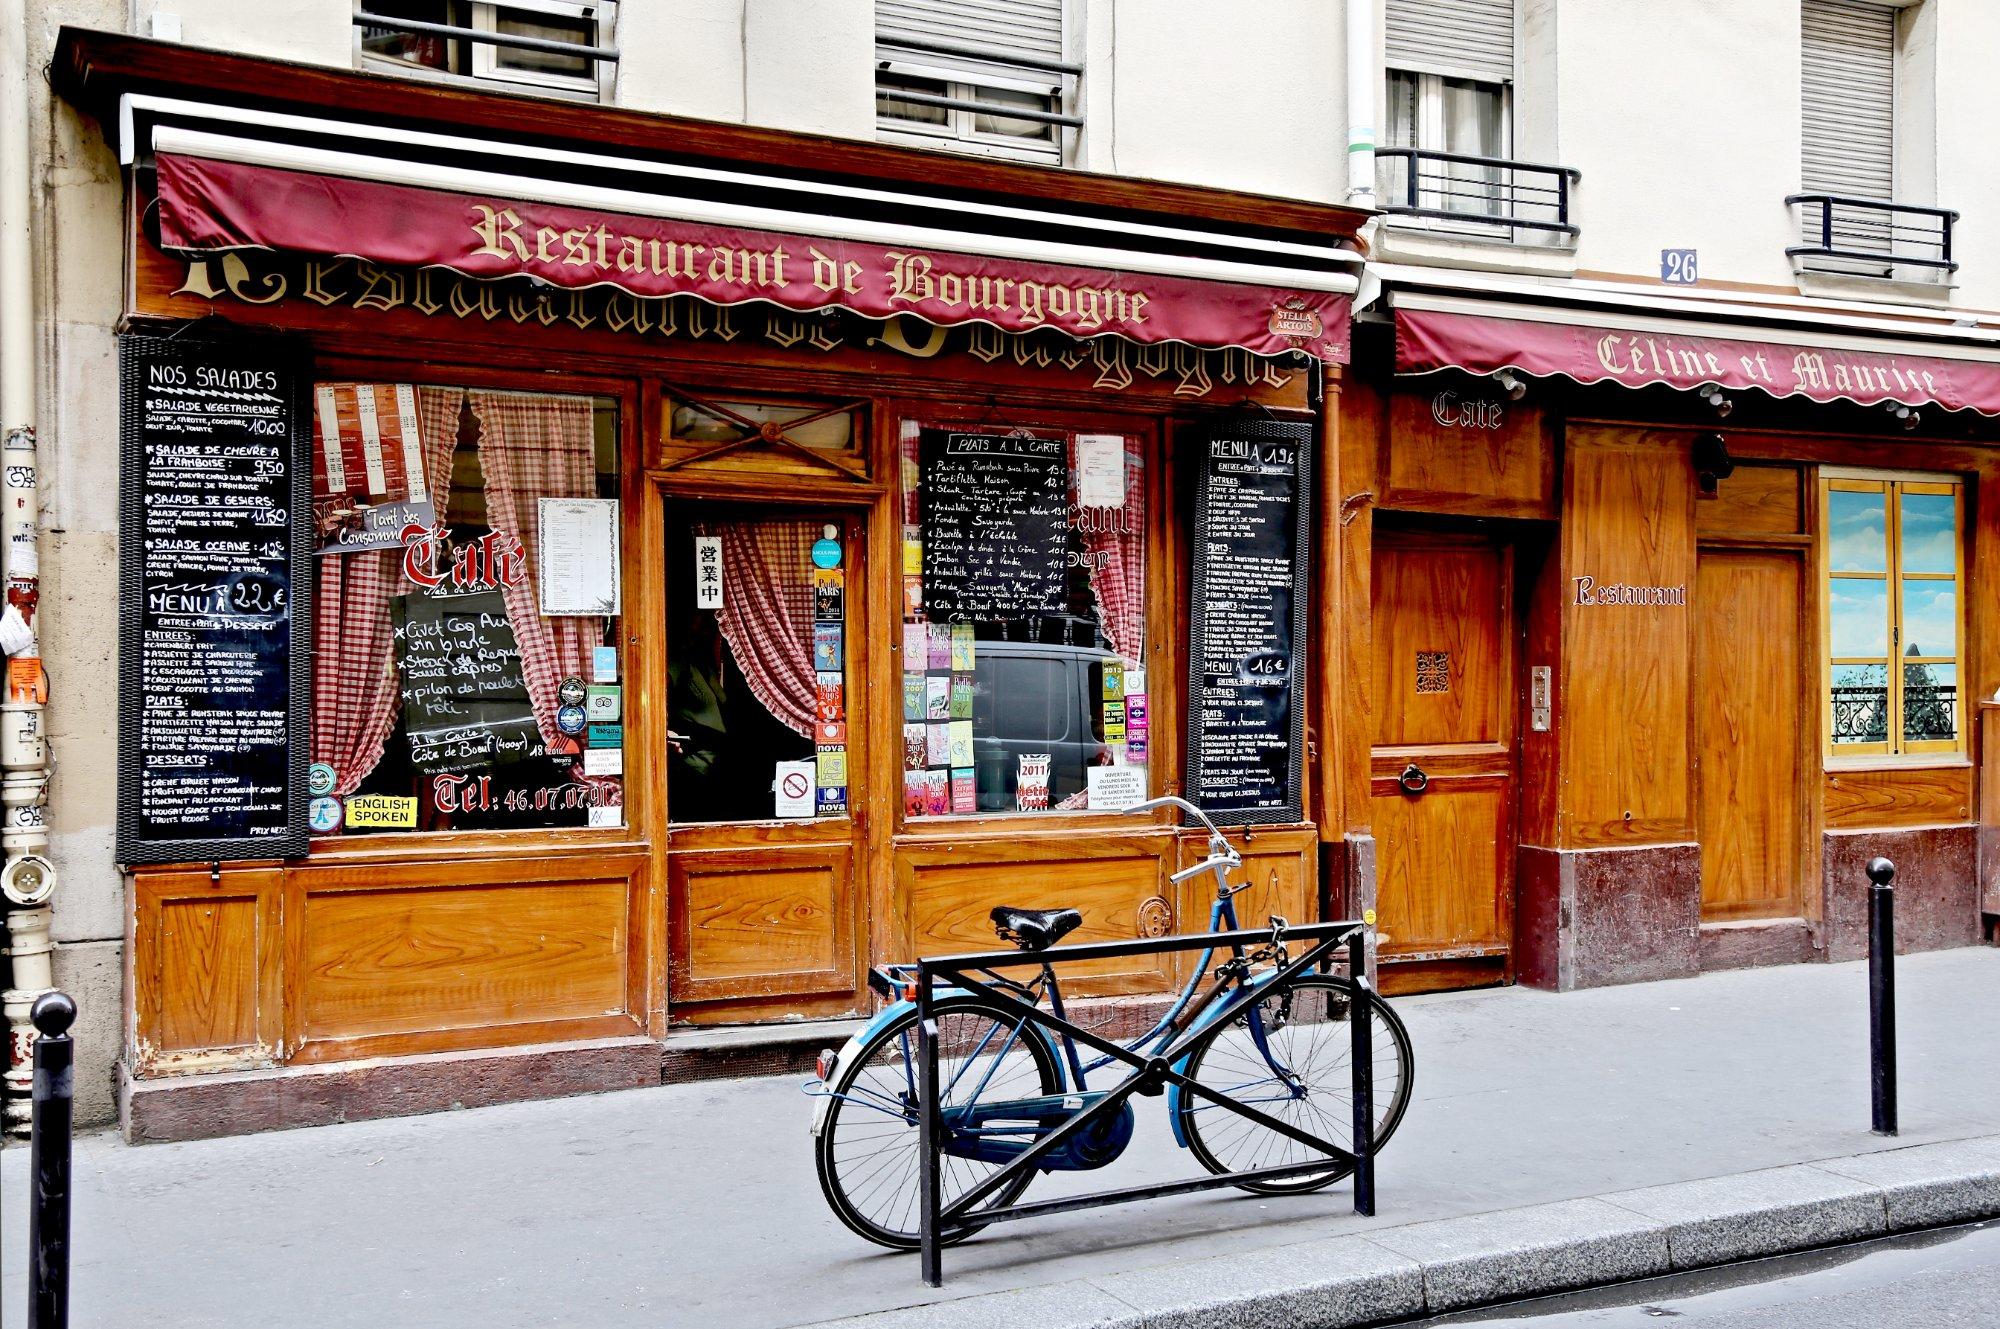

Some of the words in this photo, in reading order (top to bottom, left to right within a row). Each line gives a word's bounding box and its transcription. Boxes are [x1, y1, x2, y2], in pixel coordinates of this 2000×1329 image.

[470, 203, 791, 290] Restaurant
[809, 245, 865, 295] de
[883, 250, 1151, 328] Bourgogne
[1665, 252, 1697, 283] 26
[1277, 311, 1313, 321] STELLA
[1276, 321, 1313, 332] ARTOIS
[1596, 333, 1726, 377] Céline
[1739, 349, 1773, 384] et
[1792, 351, 1940, 395] Maurice
[150, 365, 187, 385] NOS
[195, 366, 278, 390] SALADES
[154, 398, 202, 412] SALADE
[155, 444, 202, 456] SALADE
[204, 446, 222, 455] DE
[223, 447, 268, 456] CHEVRE
[957, 438, 991, 451] PLATS
[1029, 441, 1061, 454] CARTE
[1211, 440, 1249, 457] MENU
[148, 457, 165, 466] LA
[153, 492, 200, 505] SALADE
[204, 495, 221, 506] DE
[366, 507, 400, 531] Tarif
[402, 506, 422, 526] des
[154, 537, 202, 551] SALADE
[400, 522, 528, 592] Café
[700, 545, 719, 602] 営業中
[818, 586, 841, 597] PARIS
[1571, 575, 1687, 607] Restaurant
[149, 592, 211, 614] MENU
[405, 620, 445, 638] Civet
[151, 650, 190, 659] ASSIETTE
[1204, 661, 1232, 673] MENU
[411, 747, 440, 763] Côte
[444, 743, 458, 758] de
[817, 744, 845, 753] nova
[1021, 764, 1045, 776] 2011
[432, 772, 499, 814] Tel:
[353, 798, 411, 811] ENGLISH
[819, 802, 846, 812] nova
[353, 810, 410, 823] SPOKEN
